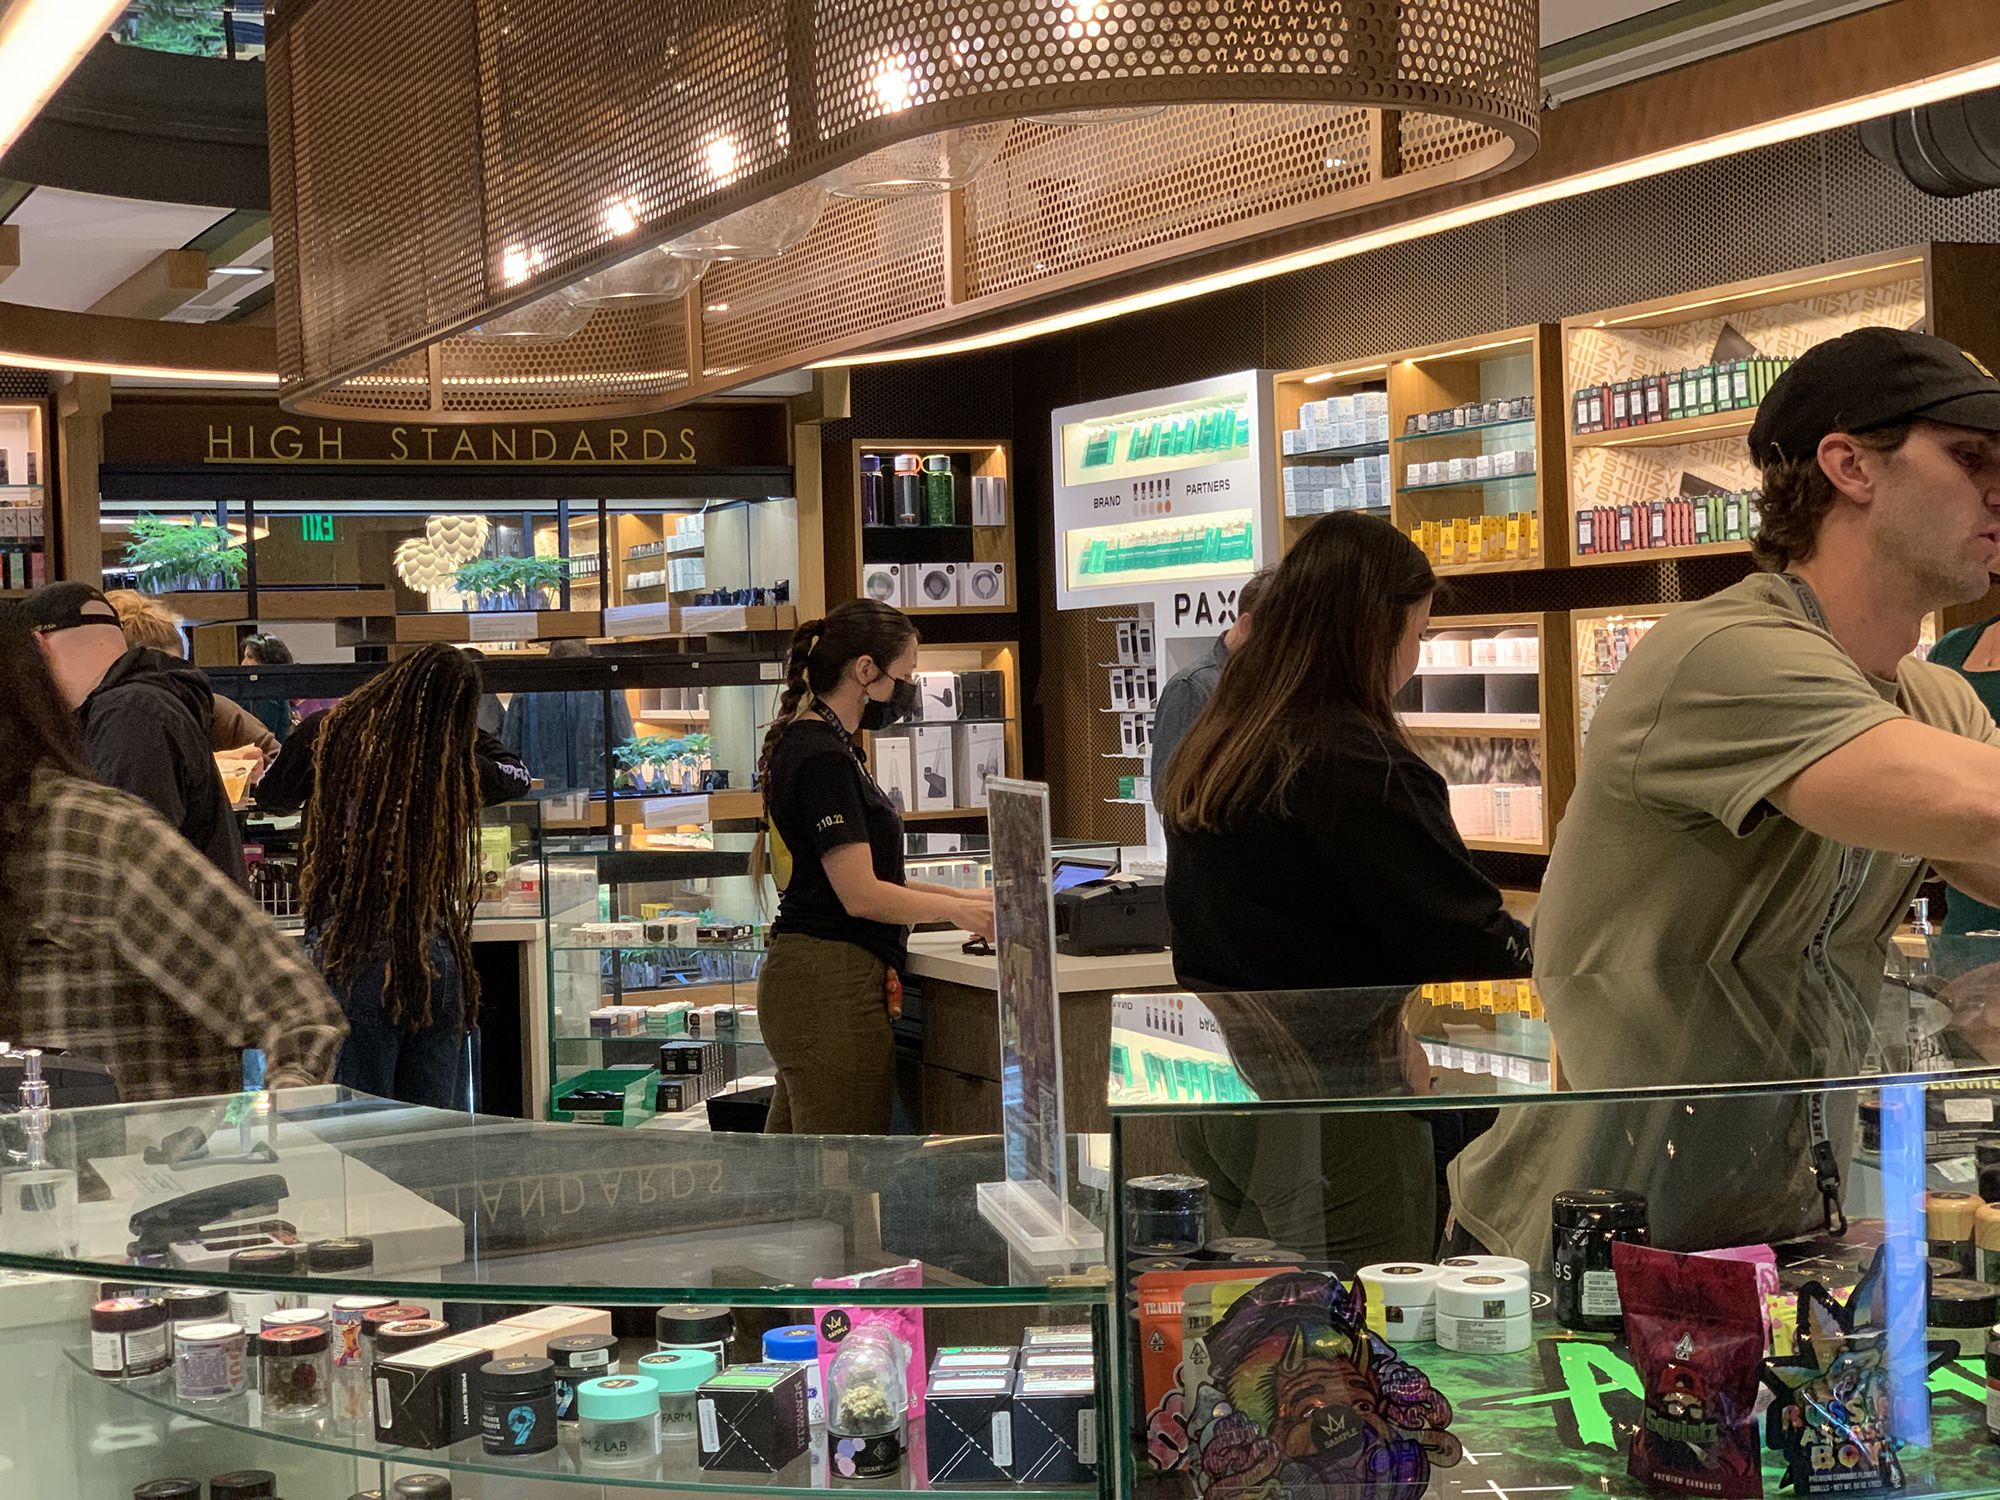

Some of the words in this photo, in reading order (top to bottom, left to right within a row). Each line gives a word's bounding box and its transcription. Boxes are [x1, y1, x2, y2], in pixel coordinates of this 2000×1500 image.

[209, 425, 342, 460] HIGH
[391, 427, 697, 461] STANDARDS
[1093, 495, 1121, 509] BRAND
[1186, 478, 1231, 496] PARTNERS
[1174, 590, 1237, 626] PAX
[827, 1325, 848, 1339] SAMPLE
[508, 1405, 537, 1446] 9
[662, 1412, 692, 1423] FARM
[1646, 1408, 1718, 1441] Squintz
[604, 1441, 628, 1452] LAB
[1324, 1427, 1359, 1449] SAMPLE
